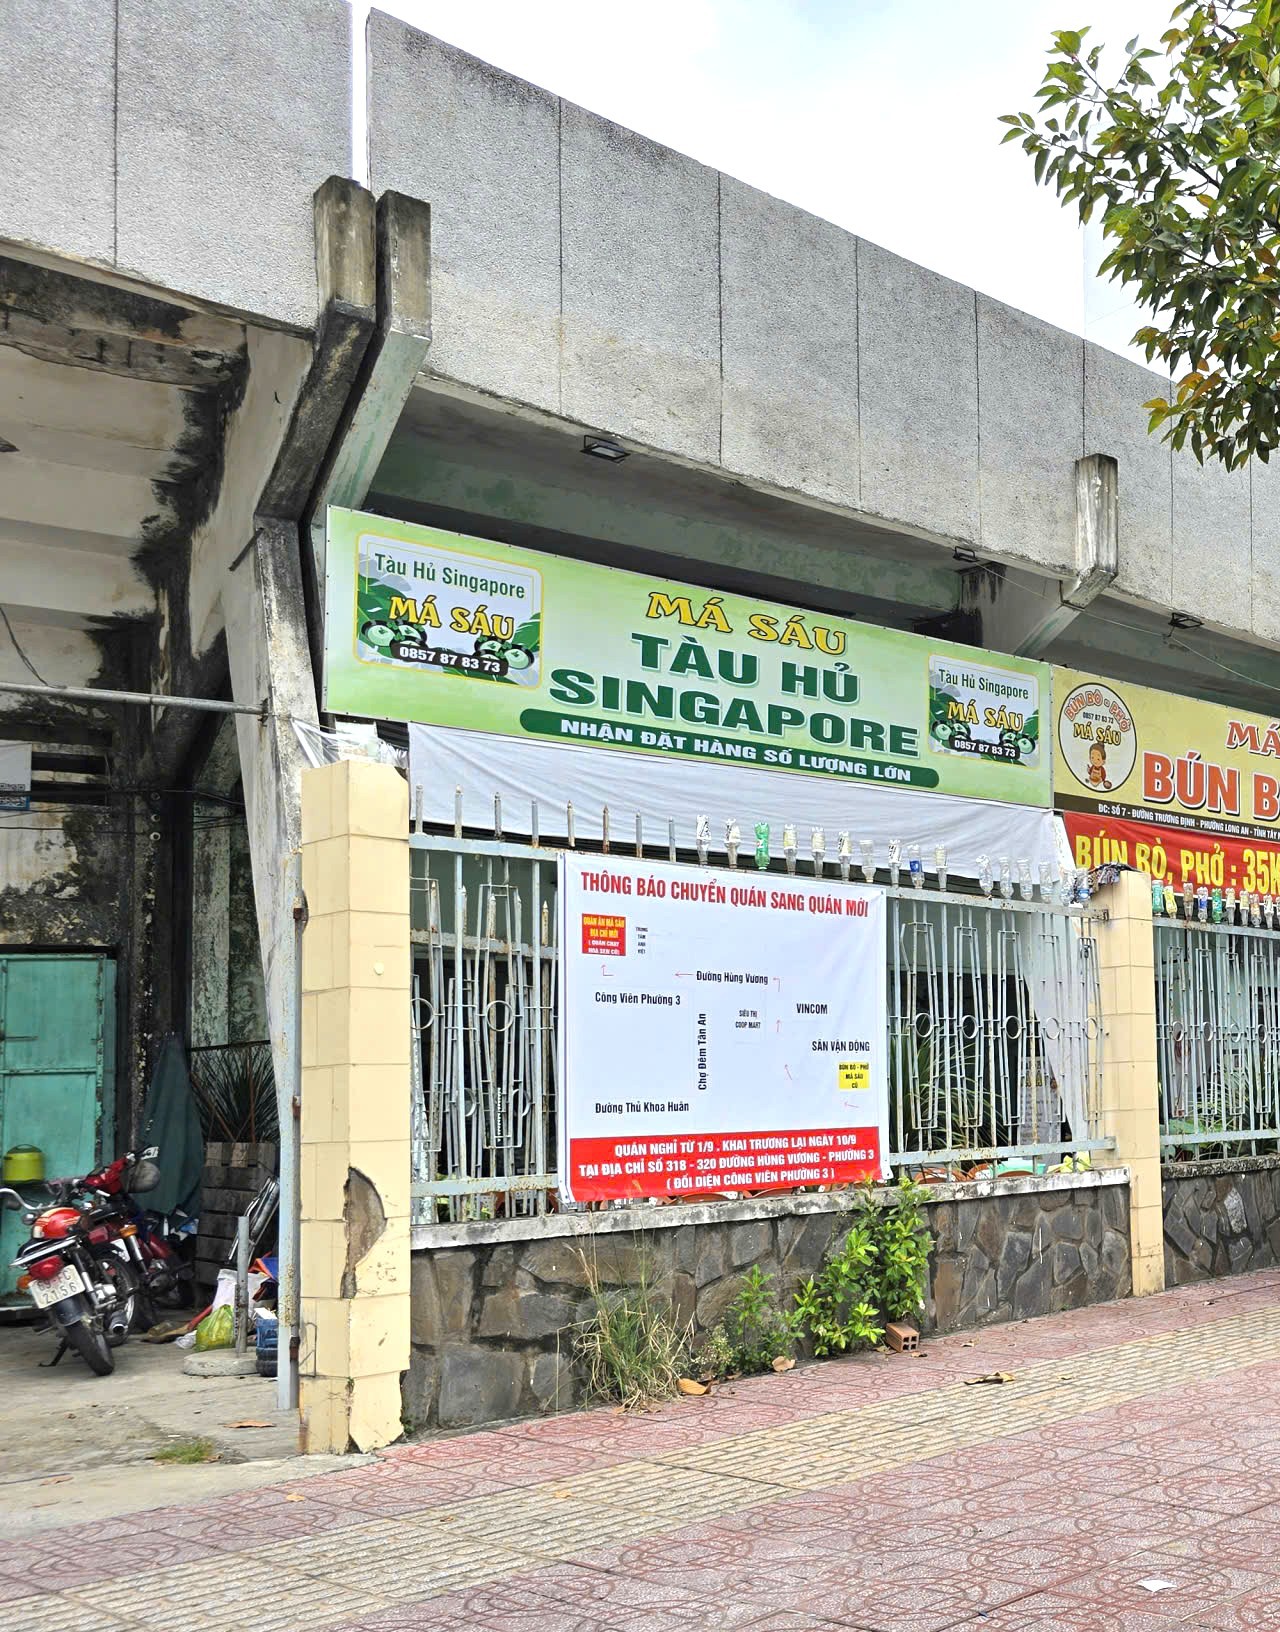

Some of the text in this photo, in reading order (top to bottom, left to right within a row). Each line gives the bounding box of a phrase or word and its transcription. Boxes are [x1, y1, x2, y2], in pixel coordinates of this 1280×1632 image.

[375, 553, 525, 599] Tàu Hủ Singapore
[388, 594, 514, 640] MÁ SÁU
[646, 591, 846, 655] MÁ SÁU
[400, 647, 501, 673] 0857 87 83 73
[631, 632, 859, 703] TÀU HỦ
[939, 669, 1029, 699] Tàu Hủ Singapore
[549, 668, 919, 756] SINGAPORE
[948, 699, 1024, 731] MÁ SÁU
[1064, 689, 1131, 732] BÚN BÒ PHỞ
[954, 741, 1016, 757] 0857 87 83 73
[1073, 721, 1121, 746] MÁ SÁU
[560, 719, 911, 781] NHẬN ĐẶT HÀNG SỐ LƯỢNG LỚN
[1143, 752, 1240, 815] BÚN
[1098, 804, 1110, 813] ĐC:
[1111, 804, 1121, 815] SỐ
[1122, 807, 1126, 816] 7
[1132, 809, 1154, 821] ĐƯỜNG
[1180, 817, 1195, 828] ĐỊNH
[1200, 819, 1224, 831] PHƯỜNG
[1225, 823, 1240, 833] LONG
[1241, 826, 1249, 835] AN
[1267, 829, 1277, 839] TÂY
[1075, 830, 1128, 870] BÚN
[1135, 837, 1173, 885] BÒ,
[1180, 842, 1225, 887] PHỞ
[581, 870, 868, 918] THÔNG BÁO CHUYỂN QUÁN SANG QUÁN MỚI
[696, 971, 769, 985] Đường Hùng Vương
[595, 992, 681, 1006] Công Viên Phường 3
[796, 1003, 828, 1014] VINCOM
[698, 1013, 709, 1090] Chợ Đêm Tân An
[811, 1039, 870, 1054] SÂN VẬN ĐỘNG
[595, 1100, 689, 1114] Đường Thủ Khoa Huân
[615, 1134, 857, 1157] QUÁN NGHỈ TỪ 1/9 KHAI TRƯƠNG LẠI NGÀY 10/9
[579, 1149, 874, 1178] TẠI ĐỊA CHỈ SỐ 318 320 ĐƯỜNG HÙNG VƯƠNG PHƯỜNG 3
[674, 1168, 829, 1189] ĐỐI DIỆN CÔNG VIÊN PHƯỜNG 3
